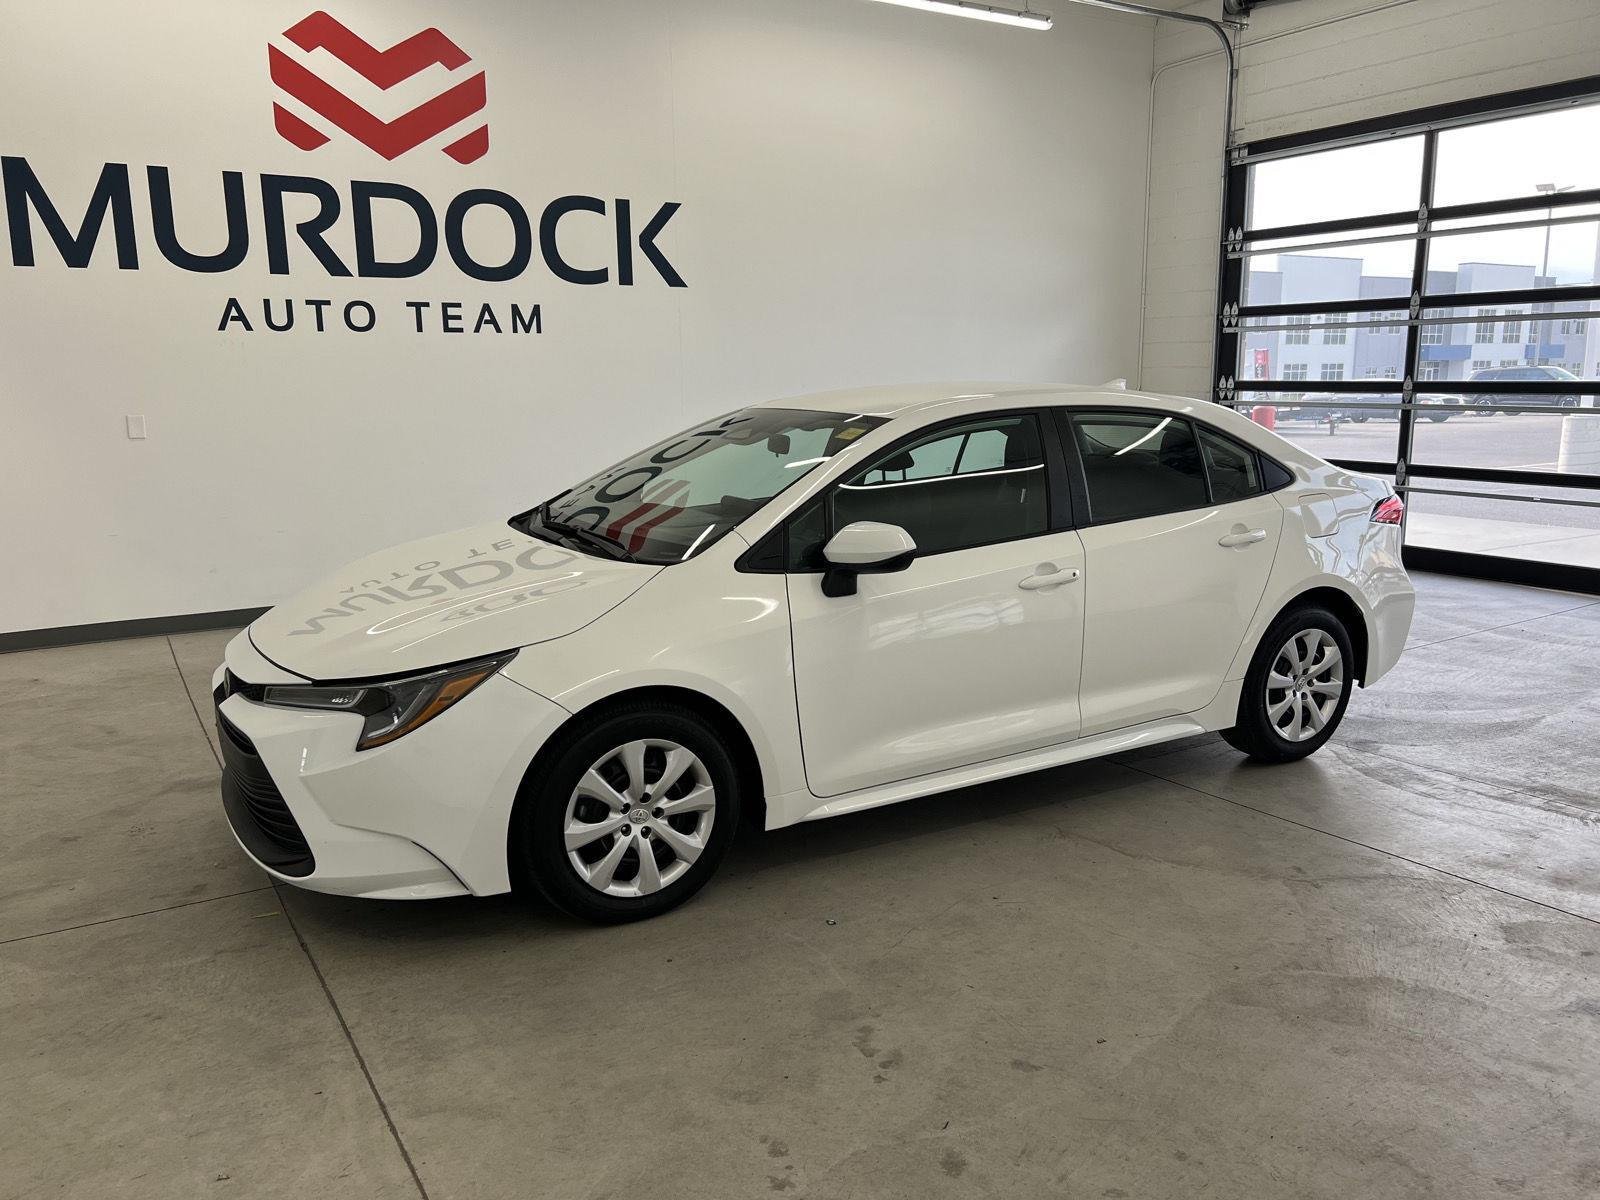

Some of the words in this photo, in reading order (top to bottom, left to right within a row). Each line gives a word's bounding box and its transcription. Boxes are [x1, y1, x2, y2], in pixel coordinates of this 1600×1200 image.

[0, 155, 689, 288] MURDOCK
[217, 297, 376, 333] AUTO
[405, 301, 542, 334] TEAM
